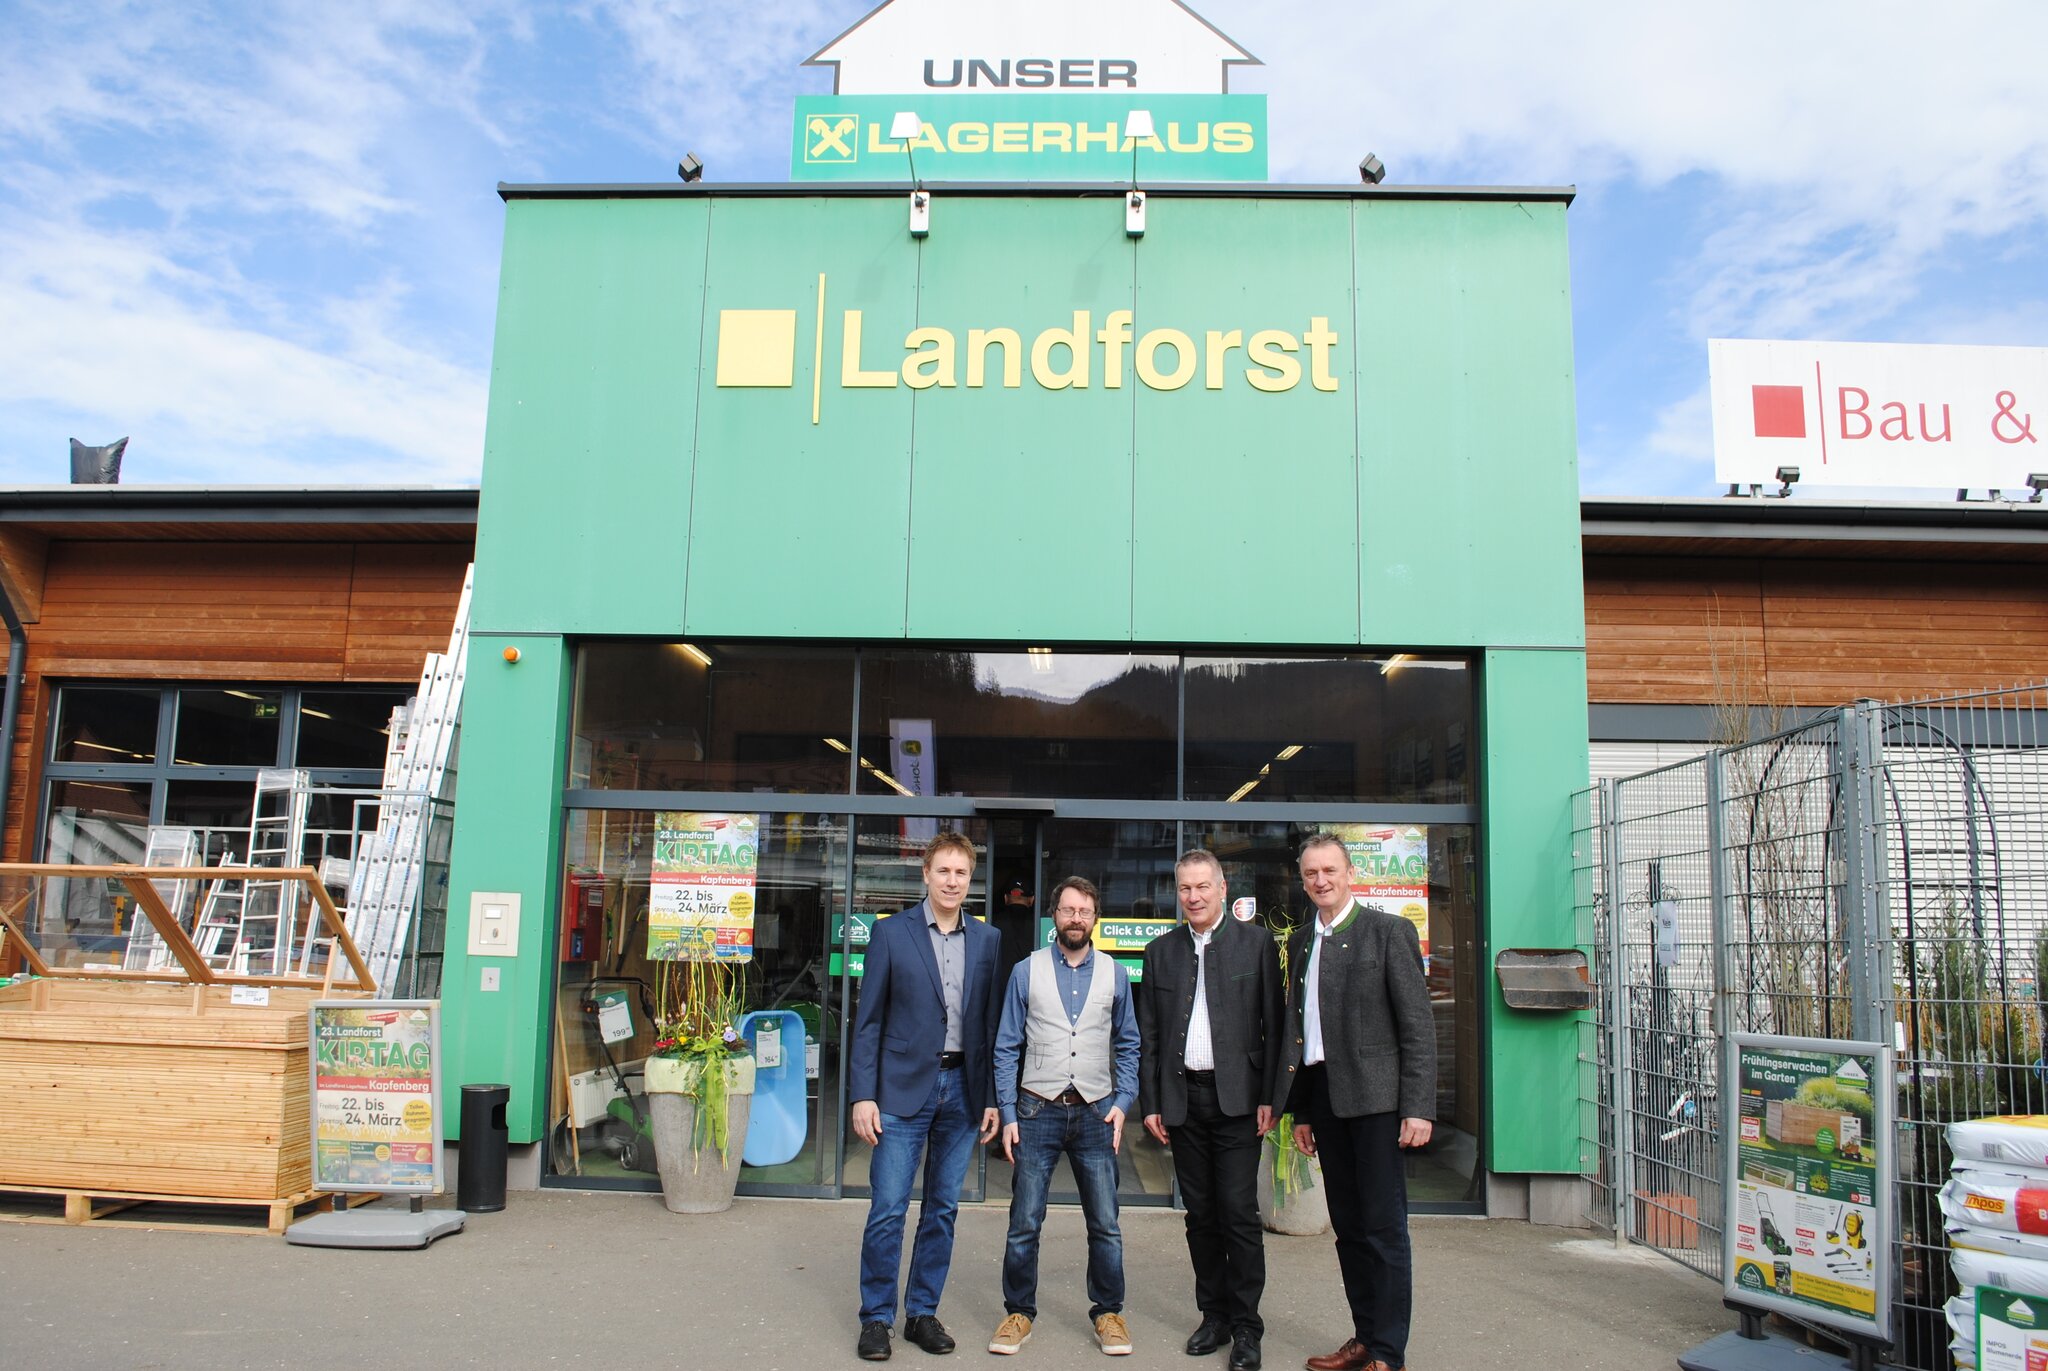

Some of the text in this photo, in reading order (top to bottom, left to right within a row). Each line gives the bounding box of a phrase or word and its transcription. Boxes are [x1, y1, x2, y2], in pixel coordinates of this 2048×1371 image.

[923, 59, 1138, 88] UNSER
[867, 122, 1255, 154] LAGERHAUS
[841, 309, 1338, 392] Landforst
[1838, 386, 2038, 444] Bau &
[660, 831, 713, 840] 23. Landforst
[1345, 843, 1380, 851] andforst
[656, 841, 754, 867] KIRTAG
[1350, 853, 1424, 879] RTAG
[700, 875, 752, 886] Kapfenberg
[676, 890, 692, 900] 22.
[696, 890, 713, 901] bis
[1370, 887, 1424, 897] Kapfenberg
[678, 902, 696, 912] 24.
[698, 903, 727, 914] März
[1104, 925, 1132, 936] Click
[1134, 926, 1142, 936] &
[321, 1028, 382, 1037] 23. Landforst
[317, 1039, 430, 1070] KIRTAG
[1742, 1054, 1828, 1074] Frühlingserwachen
[1752, 1068, 1796, 1084] im Garten
[369, 1080, 430, 1093] Kapfenberg
[342, 1098, 360, 1110] 22.
[365, 1098, 385, 1110] bis
[346, 1112, 365, 1125] 24.
[368, 1113, 402, 1126] März
